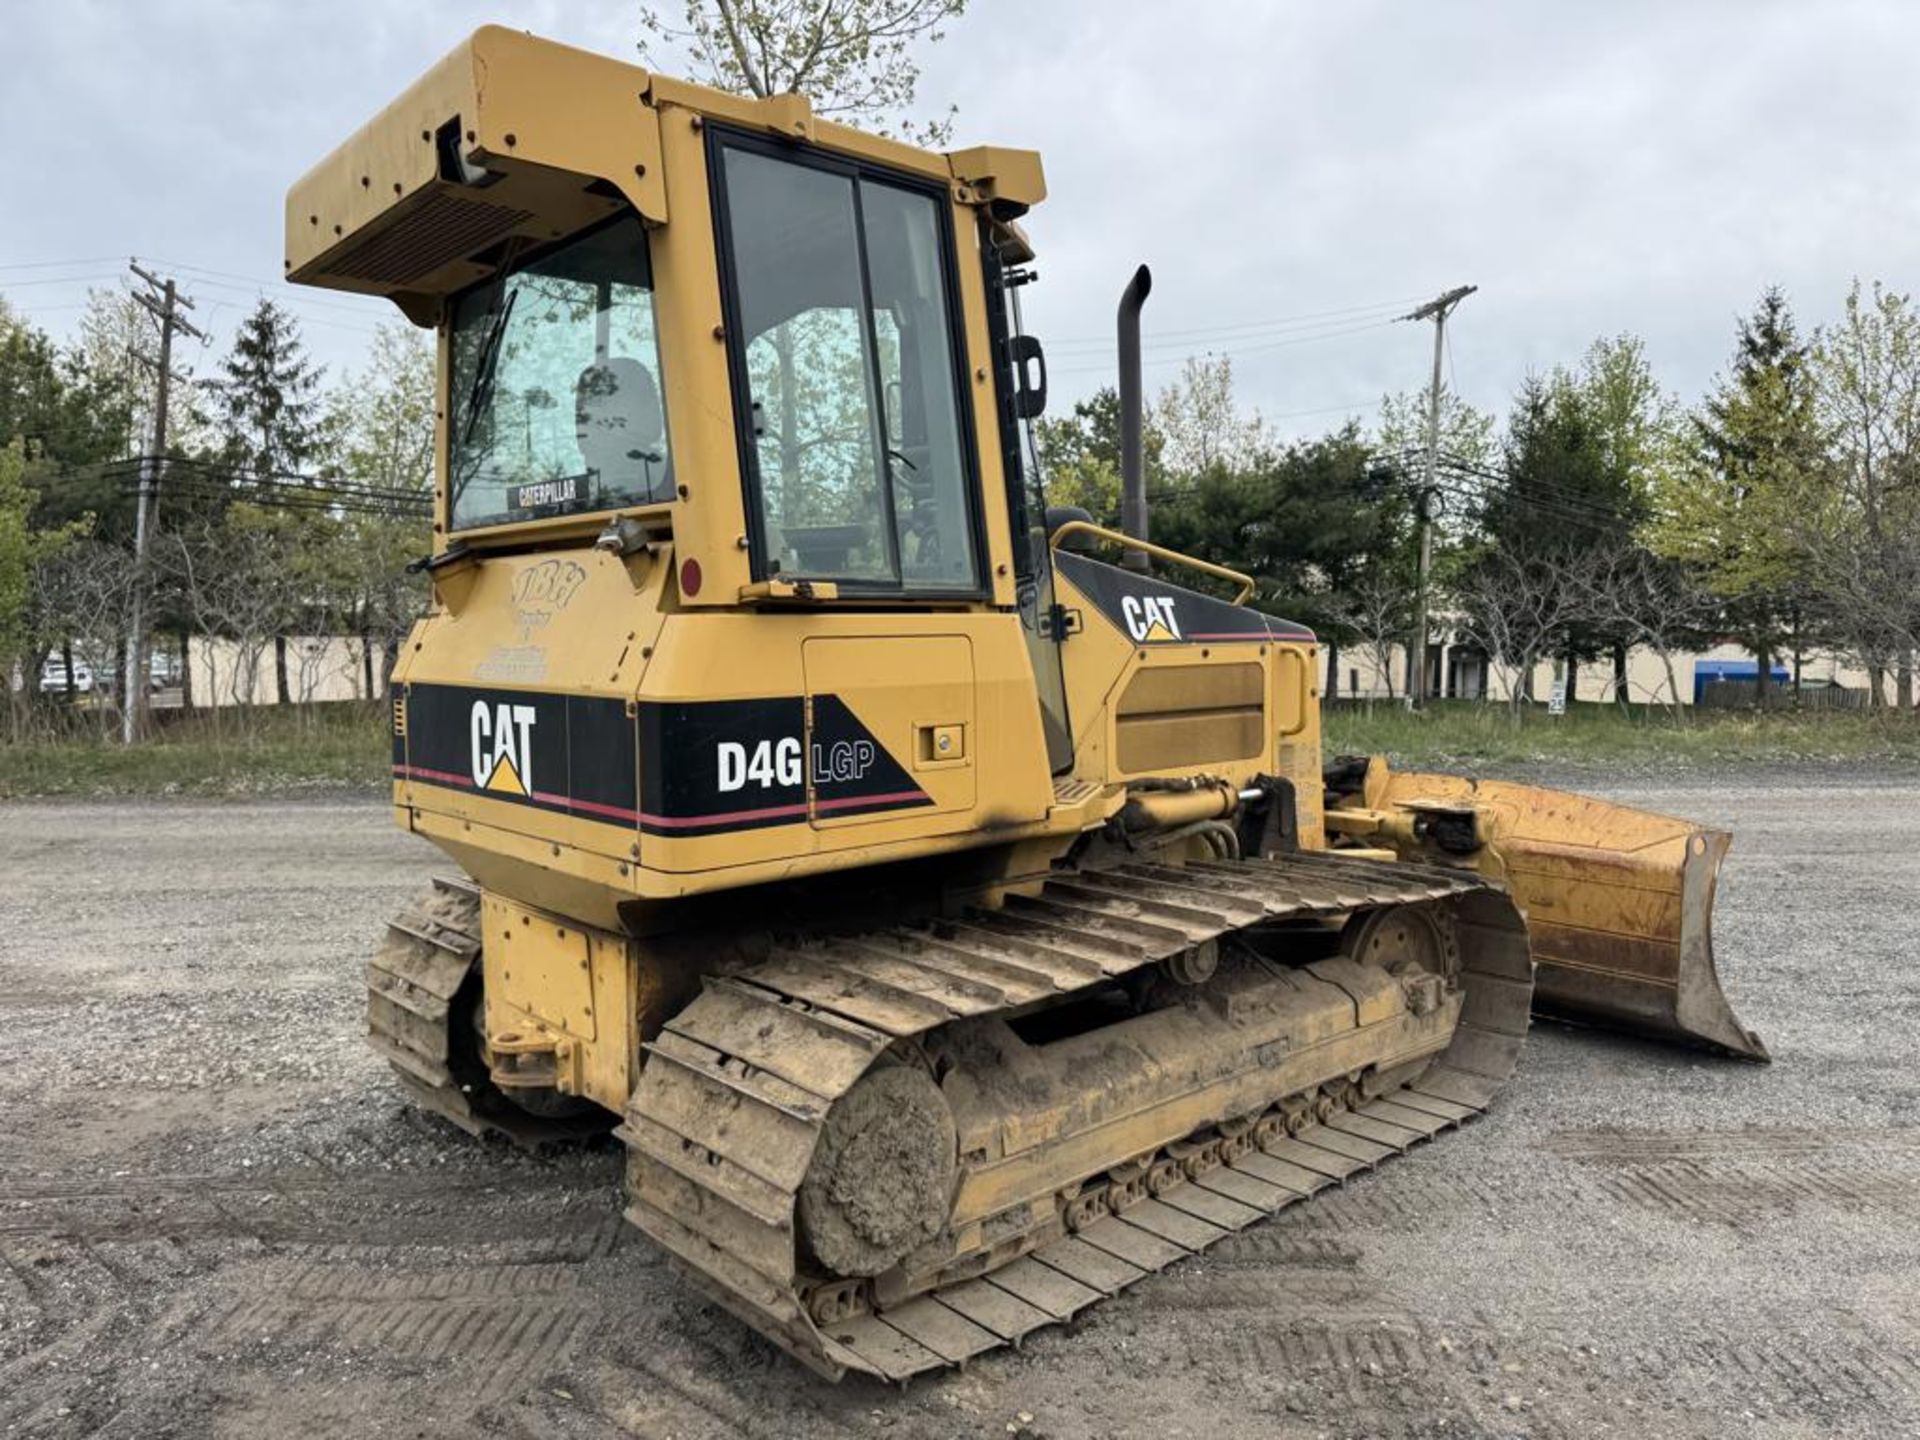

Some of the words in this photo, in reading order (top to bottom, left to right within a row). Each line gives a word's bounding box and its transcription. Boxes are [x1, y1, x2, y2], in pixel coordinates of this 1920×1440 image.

[519, 479, 576, 507] CATERPILLAR
[1121, 596, 1182, 641] CAT
[471, 700, 536, 797] CAT
[718, 737, 802, 791] D4G
[812, 741, 874, 782] LGP
